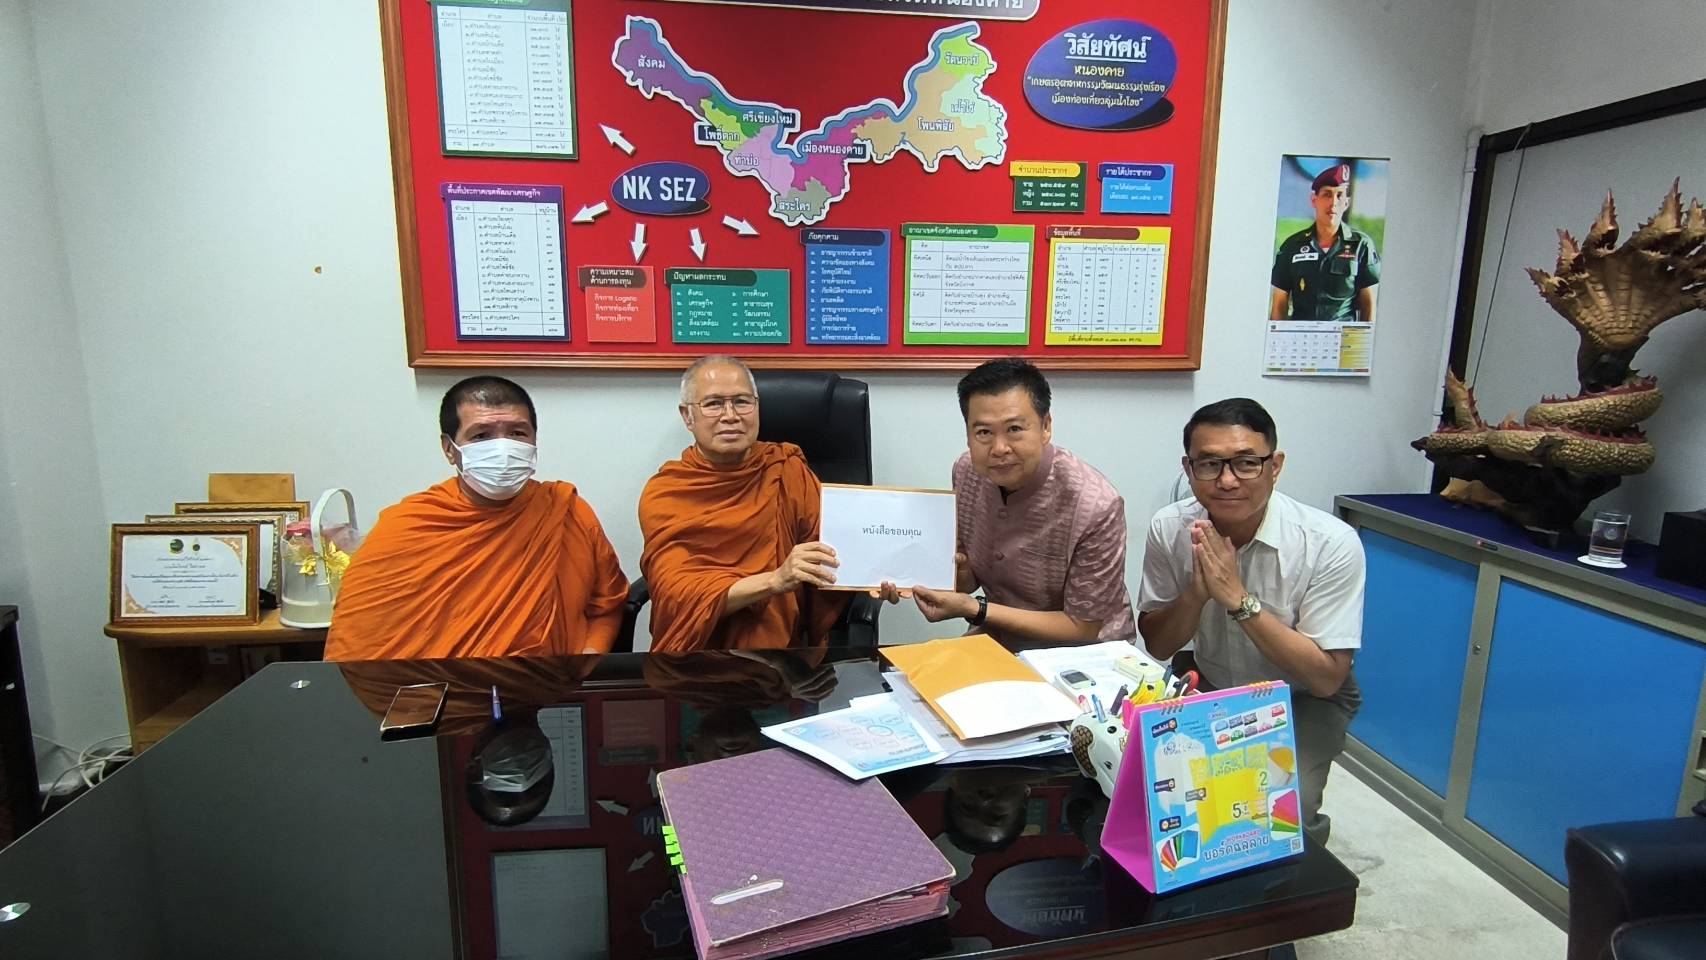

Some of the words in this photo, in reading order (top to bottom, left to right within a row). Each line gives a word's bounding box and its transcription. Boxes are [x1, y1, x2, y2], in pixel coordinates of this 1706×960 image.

[1064, 32, 1152, 58] วิสัยทัศน์
[638, 55, 665, 68] สังคม
[944, 52, 979, 65] รัตนวาปี
[1074, 65, 1124, 76] หนองคาย
[742, 111, 792, 125] ศรีเชียงใหม่
[917, 117, 954, 131] โพนพิสัย
[704, 126, 740, 142] โพธิ์ตาก
[801, 143, 863, 156] เมืองหนองคาย
[734, 153, 759, 166] ท่าบ่อ
[1105, 167, 1152, 176] รายได้ประชากร
[622, 176, 652, 200] NK
[659, 176, 696, 202] SEZ
[778, 195, 811, 211] สระใคร
[808, 232, 839, 243] ภัยคุกคาม
[673, 272, 726, 281] ปัญหาผลกระทบ
[862, 524, 922, 539] หนังสือขอบคุณ
[1259, 771, 1268, 786] 2
[1233, 803, 1242, 818] 5
[1204, 835, 1269, 860] บอร์ดฉลุลาย
